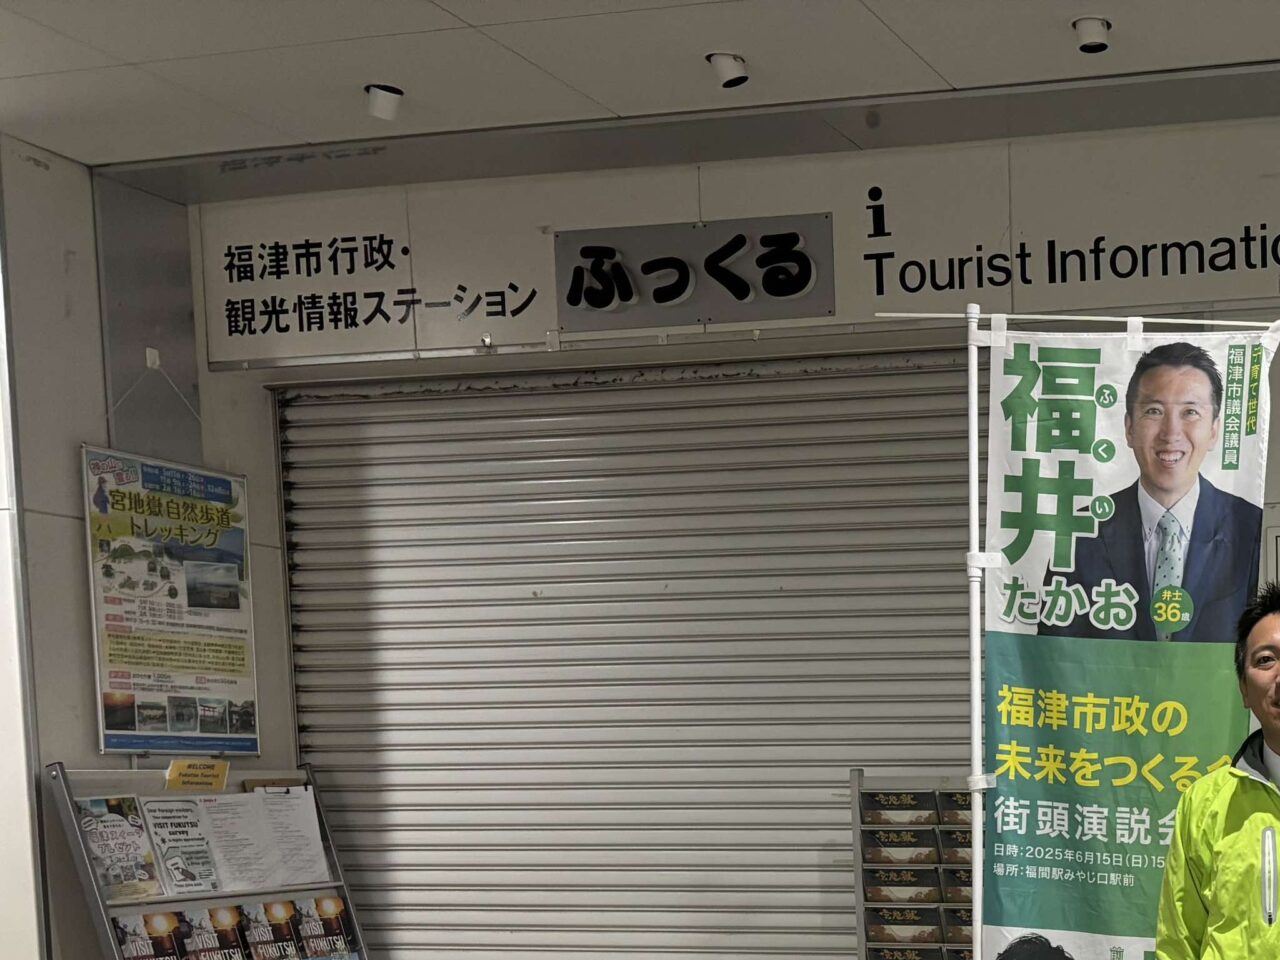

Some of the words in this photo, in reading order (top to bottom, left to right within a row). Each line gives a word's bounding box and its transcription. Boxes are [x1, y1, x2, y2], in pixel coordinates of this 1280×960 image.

[866, 186, 892, 239] i
[566, 230, 816, 309] ふっくる
[863, 241, 1032, 297] Tourist
[224, 282, 538, 337] 観光情報ステーション
[1223, 347, 1245, 466] 福津市議会議員
[1000, 342, 1101, 570] 福井
[109, 488, 232, 529] 宮地嶽自然歩道
[130, 515, 220, 547] トレッキング
[1001, 576, 1139, 630] たかお
[996, 684, 1189, 737] 福津市政の
[130, 939, 153, 956] VISIT
[196, 933, 219, 949] VISIT
[253, 926, 274, 942] VISIT
[258, 941, 296, 959] FUKUTSU
[305, 920, 325, 936] VISIT
[309, 935, 345, 951] FUKUTSU
